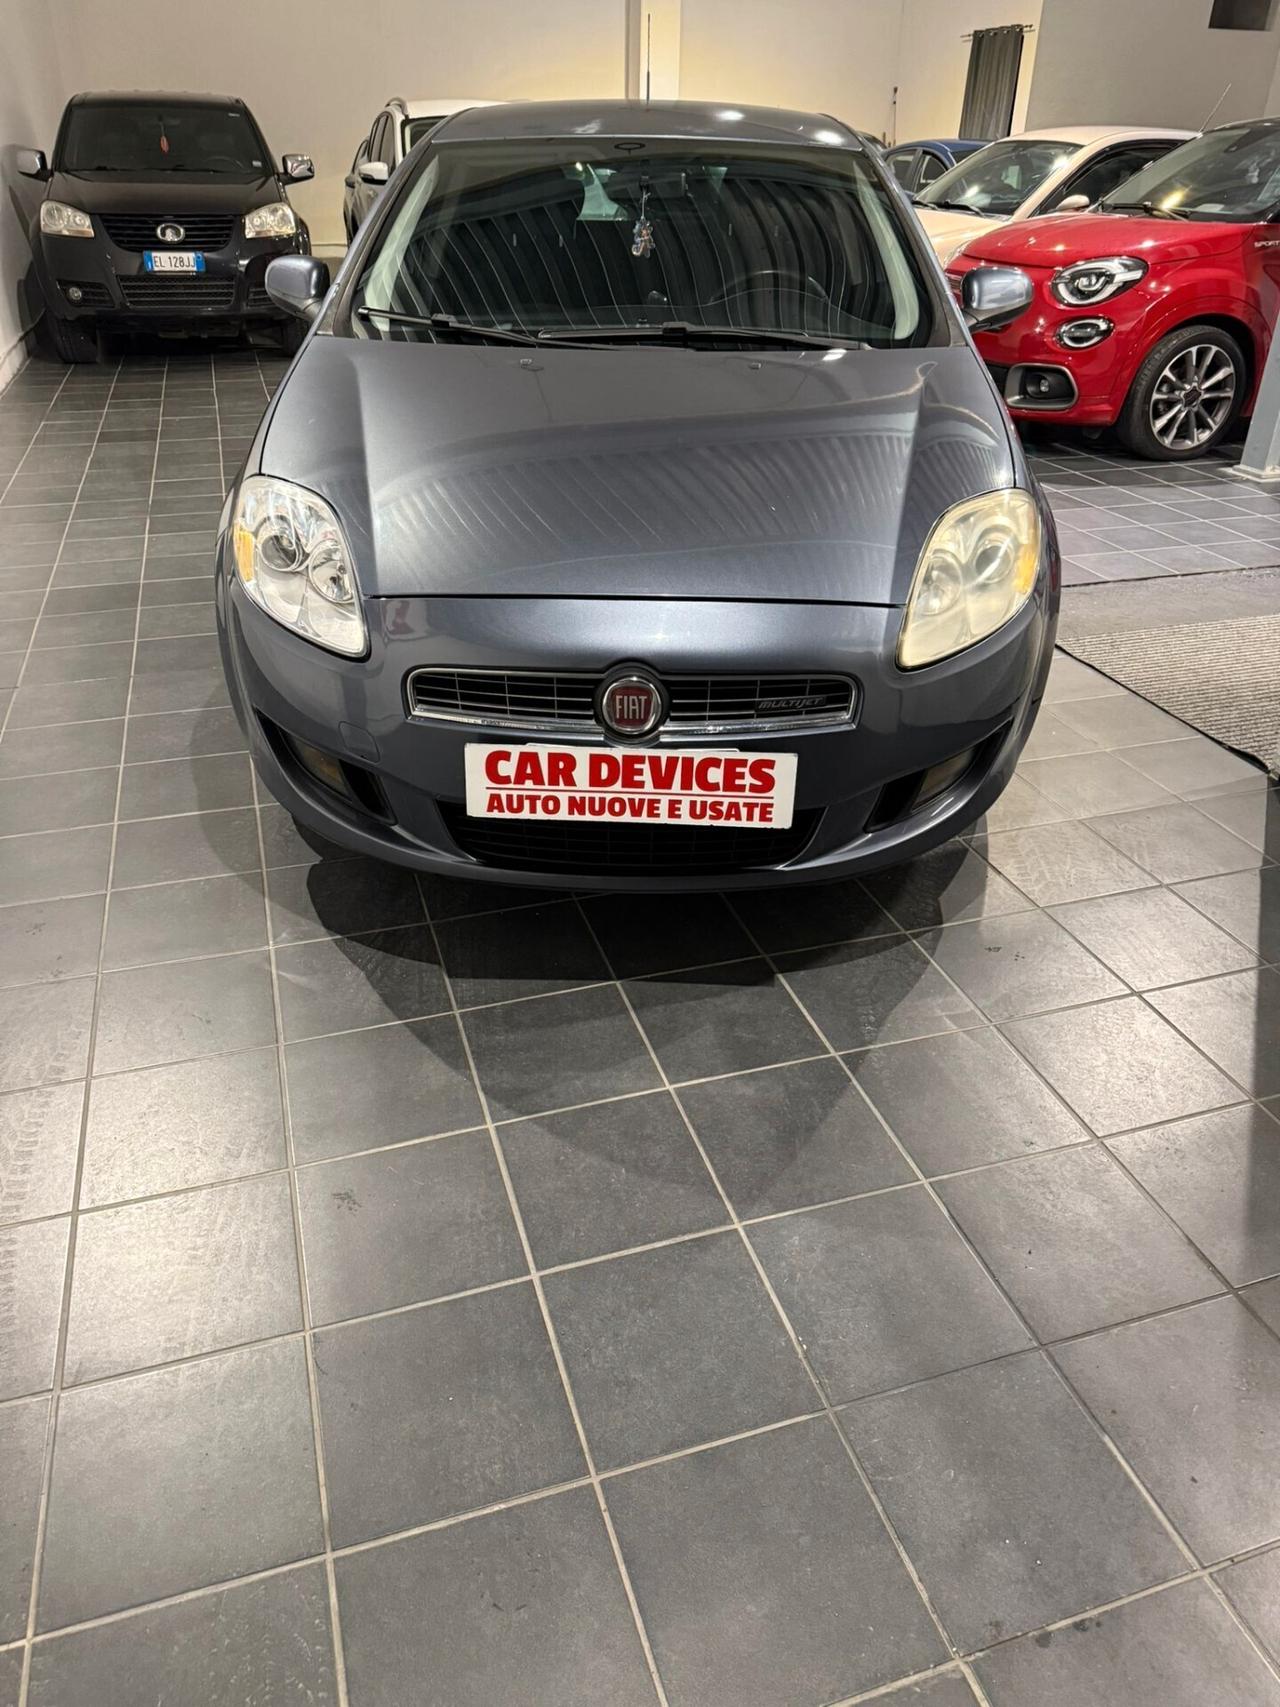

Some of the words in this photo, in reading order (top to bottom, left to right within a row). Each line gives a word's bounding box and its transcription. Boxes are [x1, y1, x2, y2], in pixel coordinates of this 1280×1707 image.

[153, 255, 165, 268] EL
[168, 255, 196, 268] 128JJ
[615, 694, 648, 720] FIAT
[484, 750, 577, 787] CAR
[588, 753, 776, 793] DEVICES
[486, 793, 561, 816] AUTO
[567, 795, 661, 818] NUOVE
[667, 799, 682, 819] E
[688, 800, 774, 823] USATE
